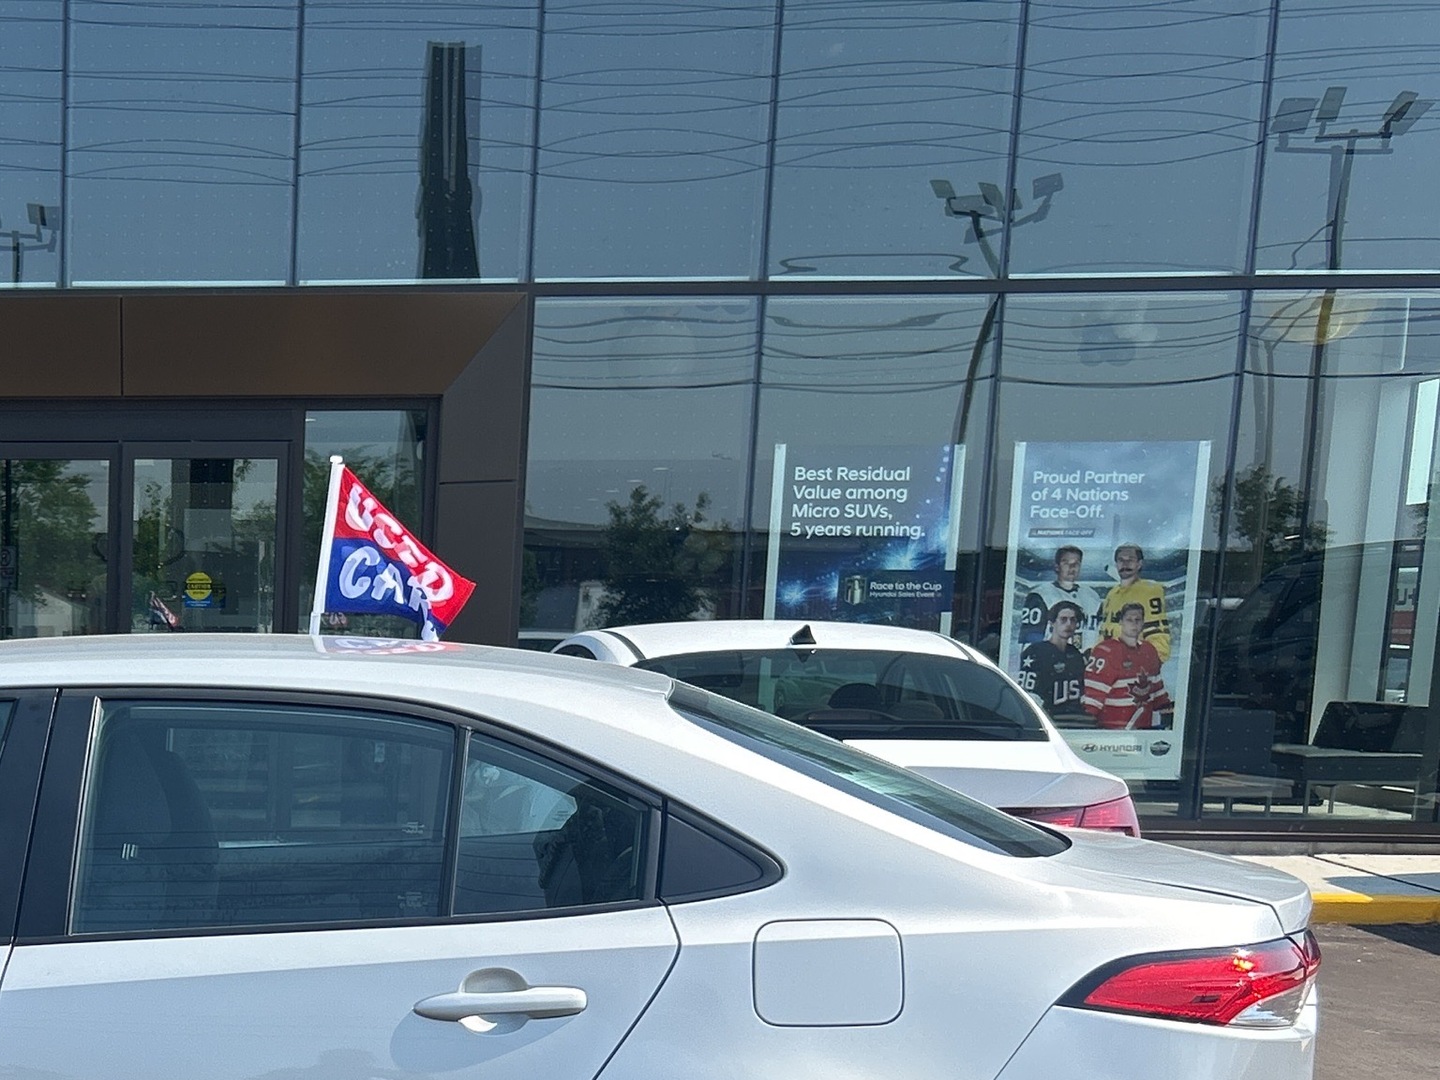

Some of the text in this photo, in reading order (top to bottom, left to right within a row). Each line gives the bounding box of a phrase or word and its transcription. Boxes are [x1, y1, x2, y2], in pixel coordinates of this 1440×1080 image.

[794, 466, 910, 481] Best Residual
[1033, 470, 1145, 484] Proud Partner
[793, 485, 908, 503] Value among
[1031, 487, 1129, 501] of 4 Nations
[792, 503, 893, 520] Micro SUVs,
[1030, 504, 1105, 519] Face-Off.
[790, 521, 925, 540] 5 years running.
[870, 582, 942, 591] Race to the Cup
[1021, 608, 1041, 625] 20
[1085, 656, 1105, 673] 29
[1100, 744, 1142, 752] HYUNDAI
